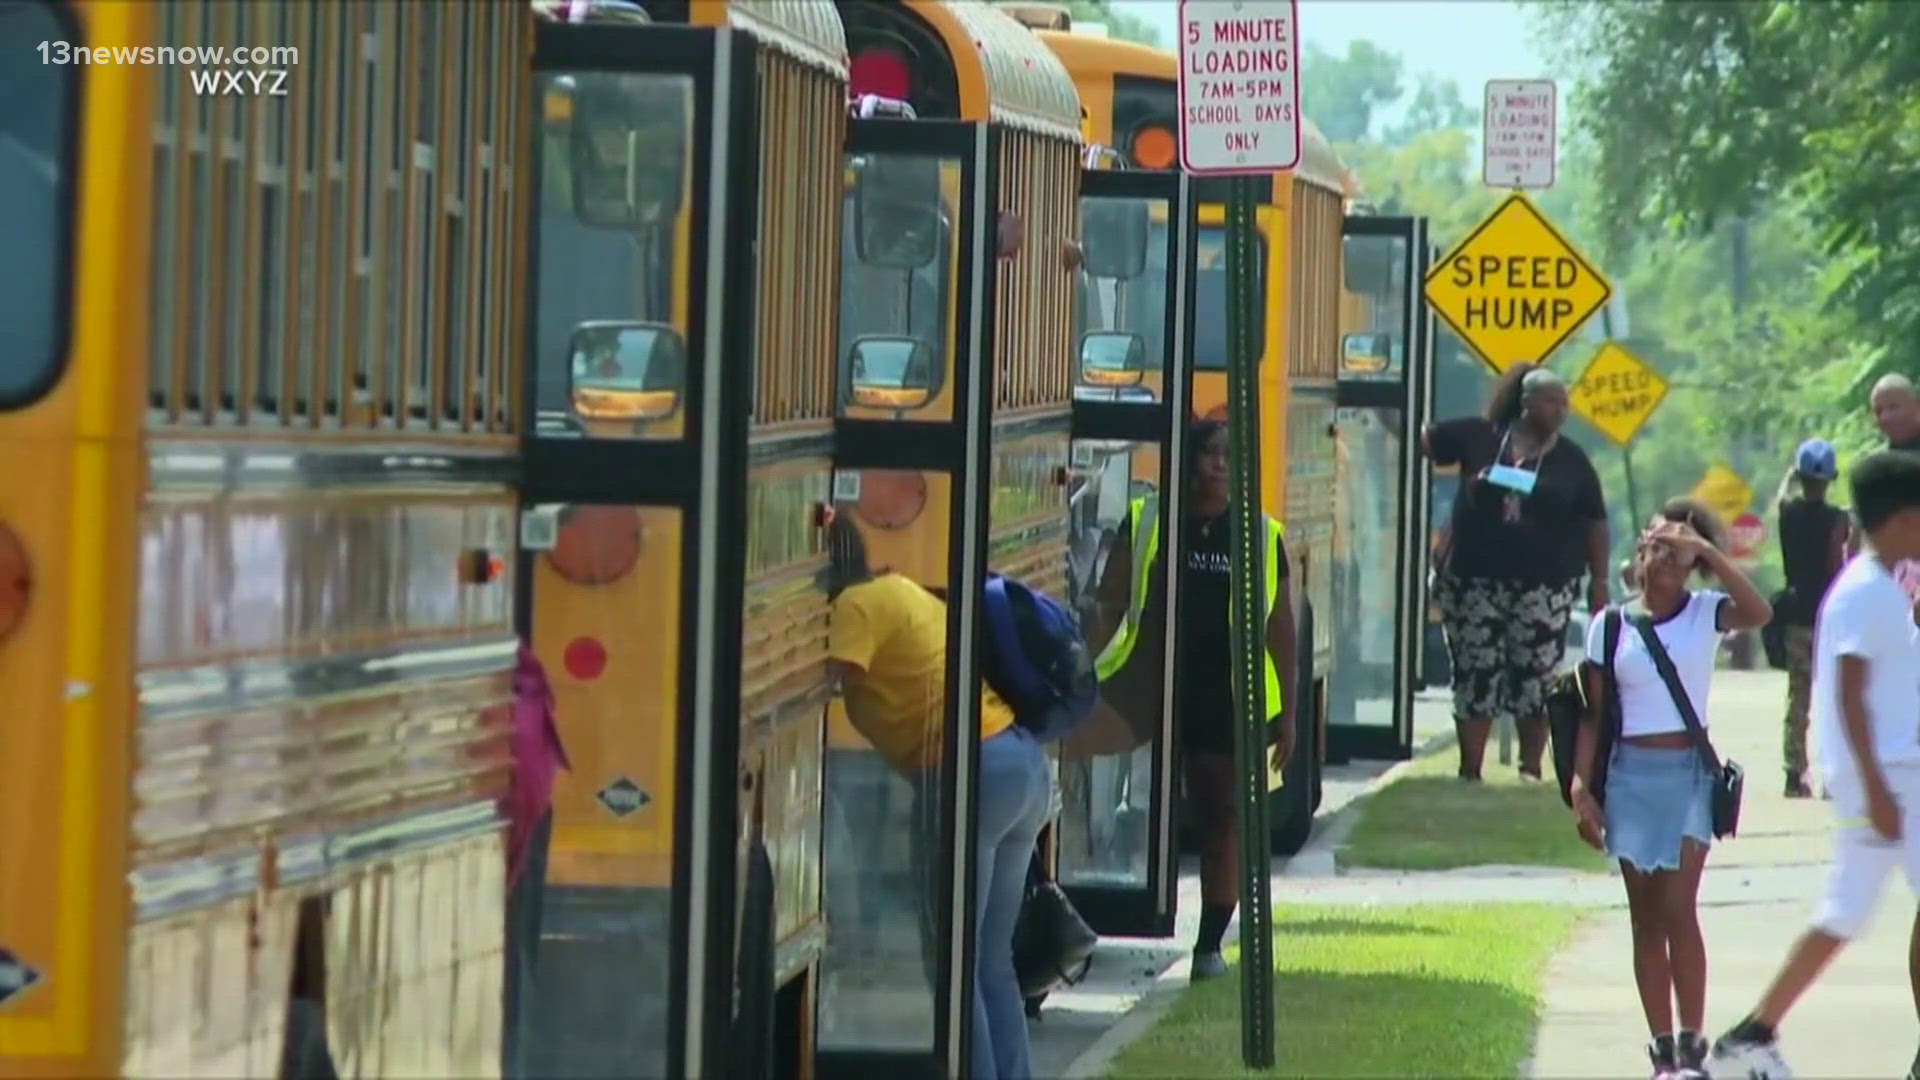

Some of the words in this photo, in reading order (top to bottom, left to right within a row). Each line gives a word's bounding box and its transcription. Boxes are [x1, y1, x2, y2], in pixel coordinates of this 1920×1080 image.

[1188, 21, 1200, 44] 5
[1214, 19, 1286, 43] MINUTE
[1192, 49, 1288, 74] LOADING
[1200, 79, 1282, 99] 7AM-5PM
[1189, 105, 1241, 124] SCHOOL
[1255, 103, 1292, 122] DAYS
[1225, 132, 1260, 150] ONLY
[1452, 255, 1578, 289] SPEED
[1464, 298, 1574, 331] HUMP
[1583, 371, 1650, 398] SPEED
[1591, 394, 1651, 417] HUMP
